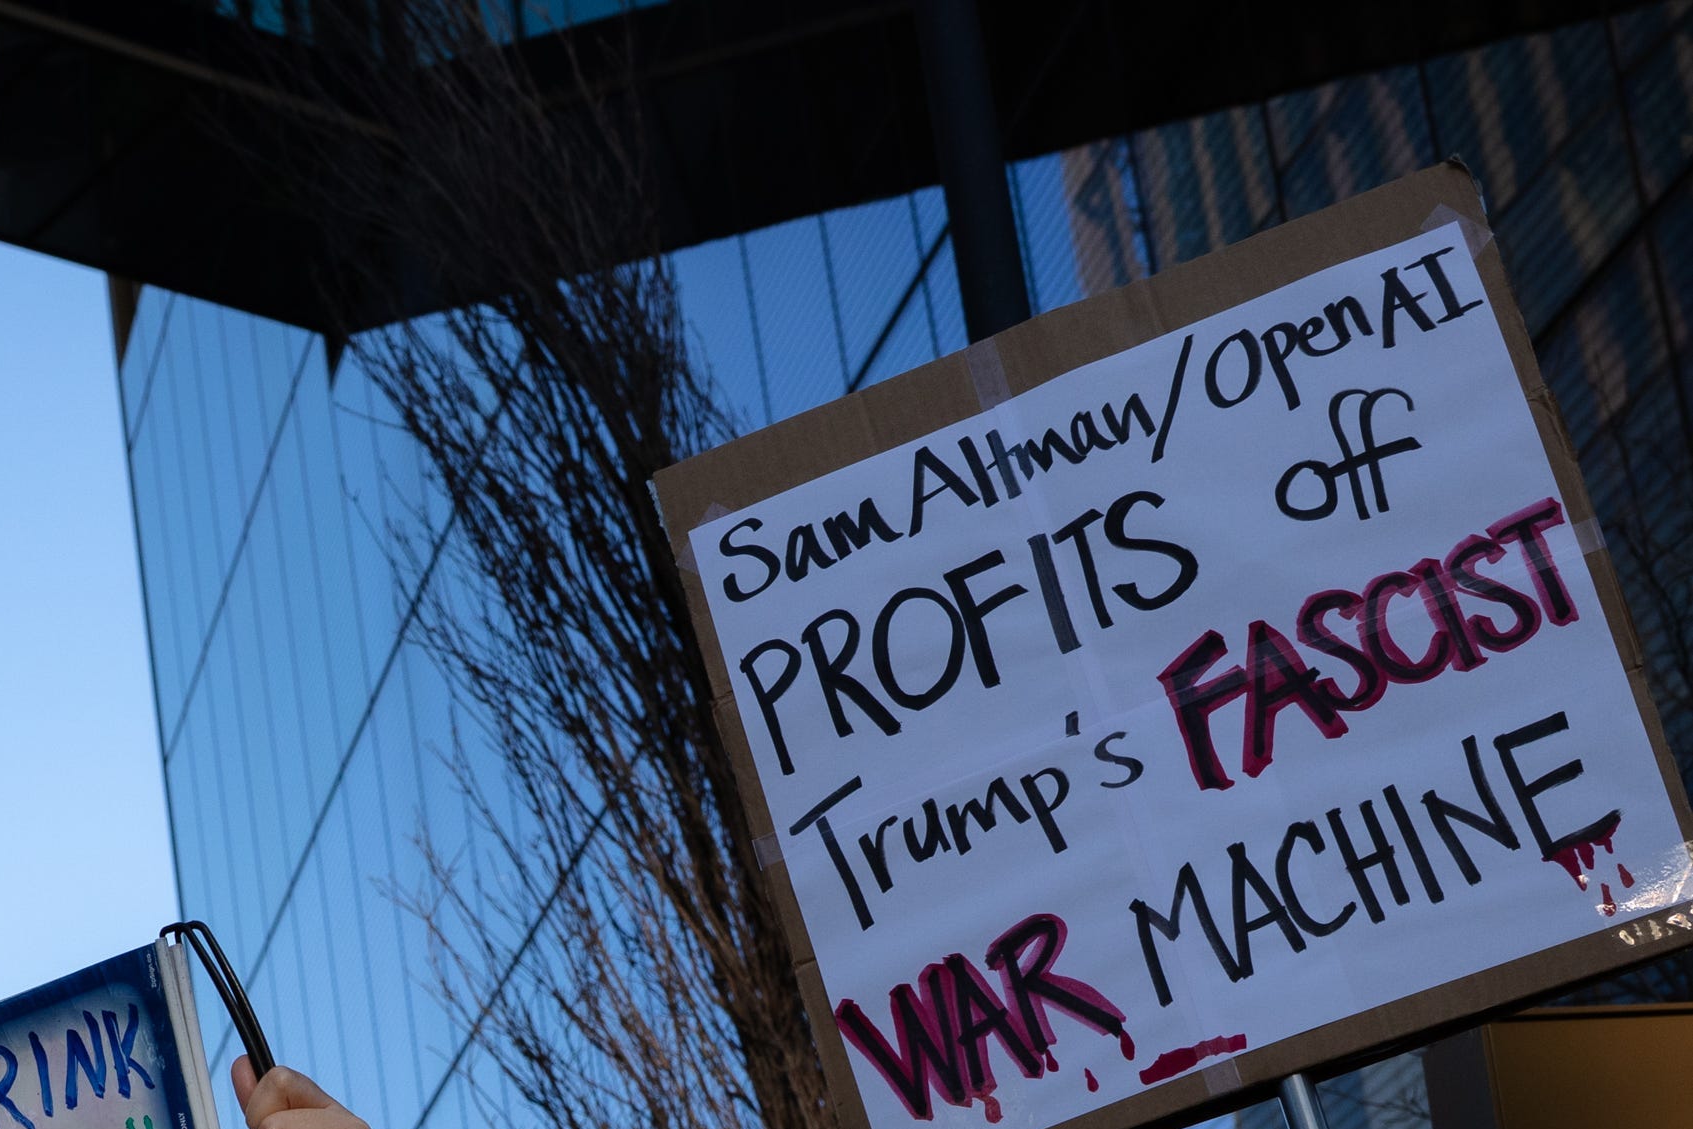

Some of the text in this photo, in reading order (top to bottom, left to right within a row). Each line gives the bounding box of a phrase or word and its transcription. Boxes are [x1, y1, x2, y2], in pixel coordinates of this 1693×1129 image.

[719, 498, 905, 602] Sam
[740, 387, 1423, 776] PROFITS off
[790, 496, 1580, 932] Trump's FASCIST
[834, 710, 1622, 1122] WAR MACHINE
